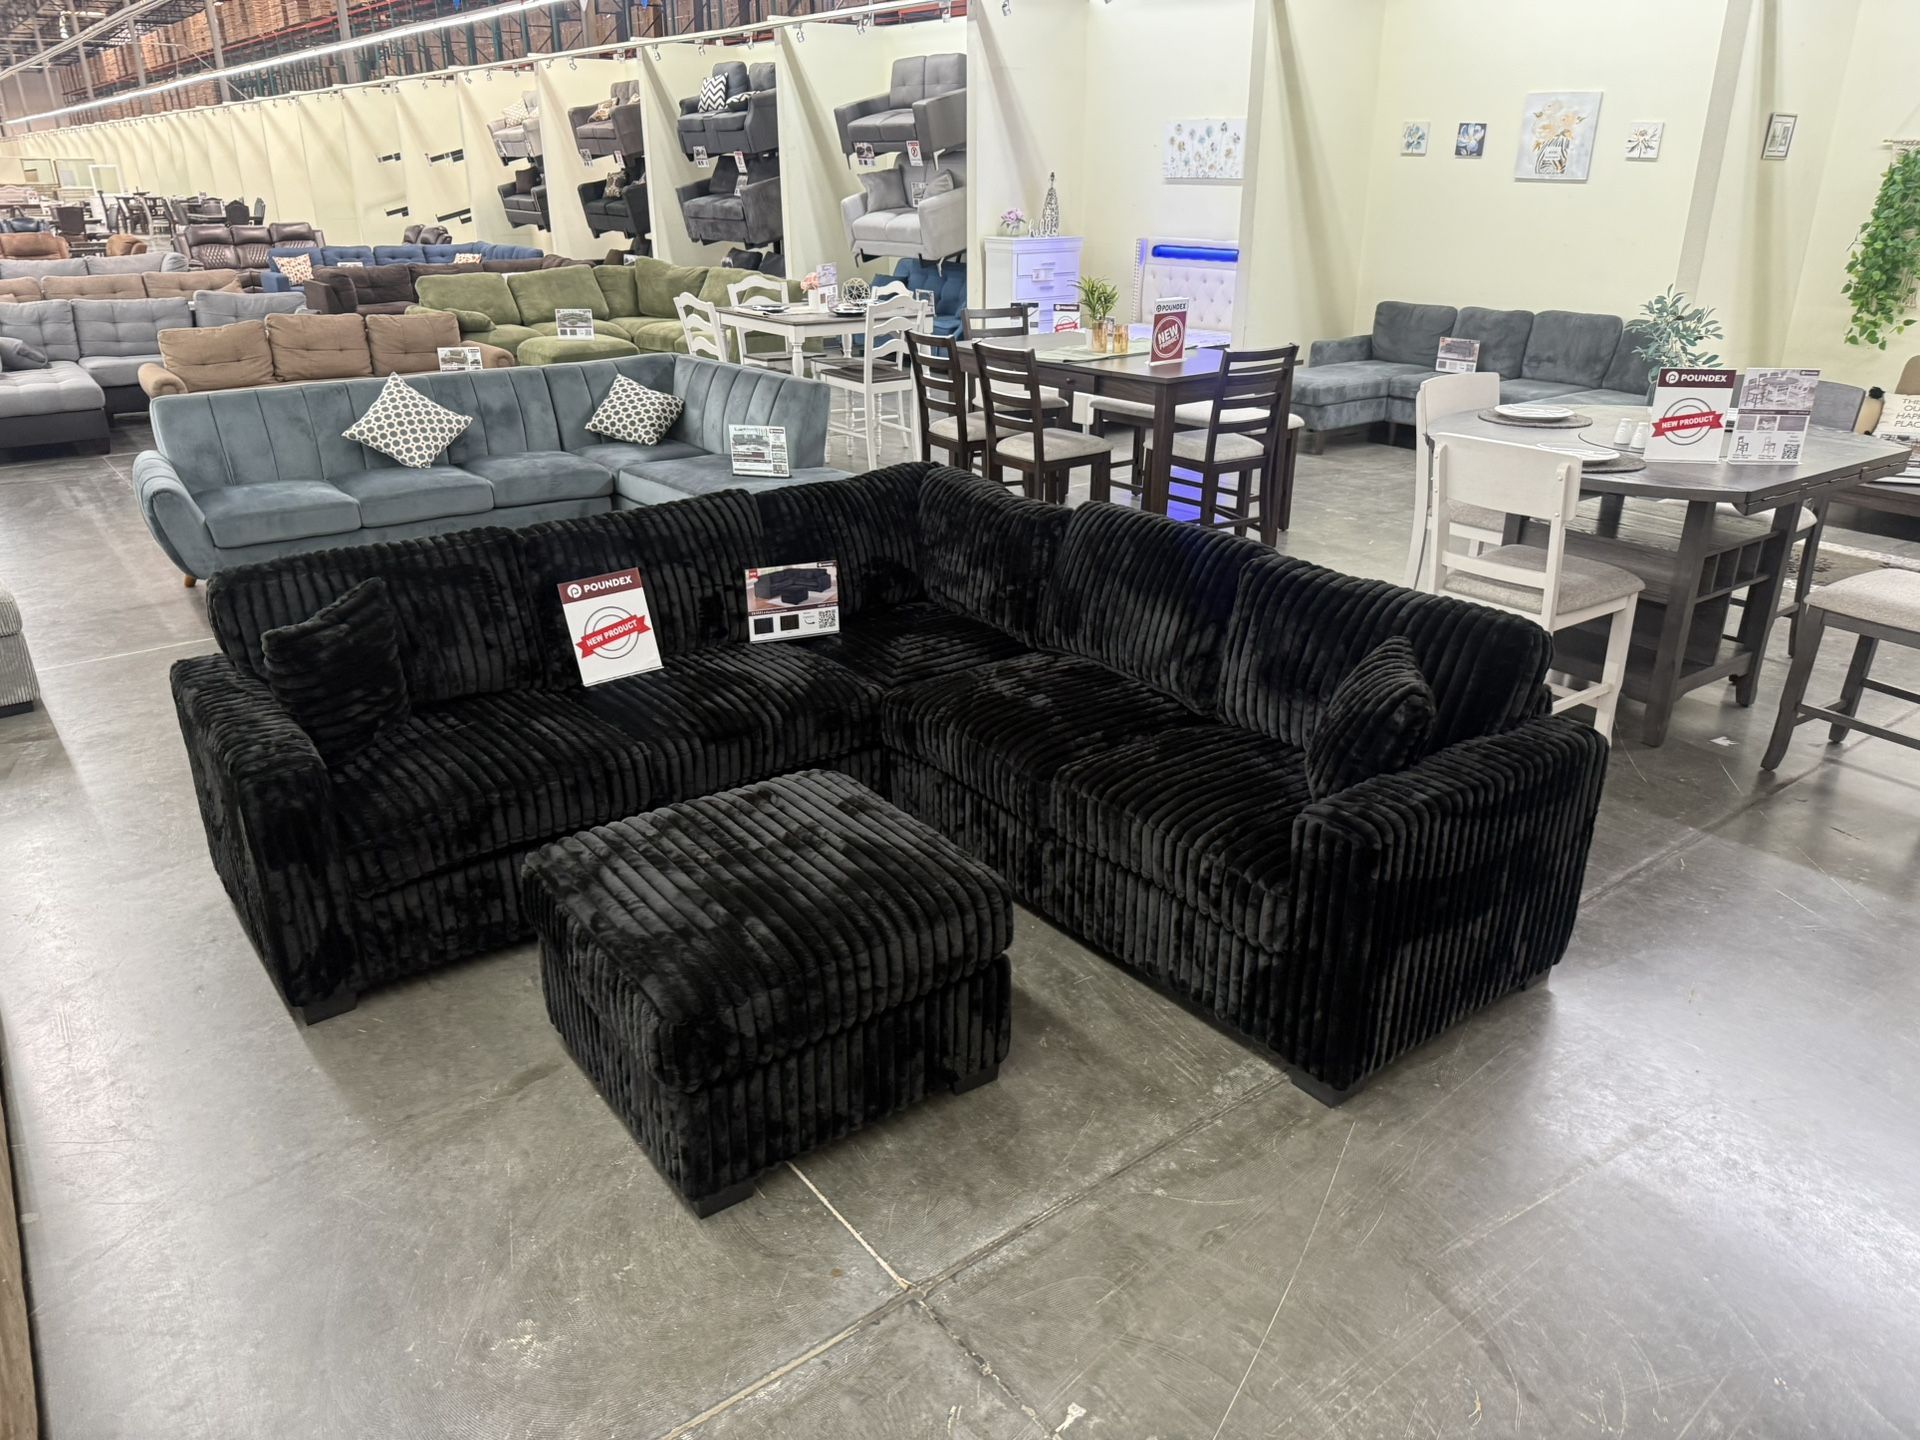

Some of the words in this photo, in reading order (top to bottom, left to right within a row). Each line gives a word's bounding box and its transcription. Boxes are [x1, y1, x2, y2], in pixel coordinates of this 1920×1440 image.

[1162, 302, 1187, 312] POUNDEX
[1157, 323, 1179, 345] NEW
[1680, 373, 1727, 383] POUNDEX
[1661, 420, 1678, 429] NEW
[1679, 415, 1714, 427] PRODUCT
[583, 575, 632, 593] POUNDEX
[586, 634, 604, 647] NEW
[603, 619, 638, 640] PRODUCT
